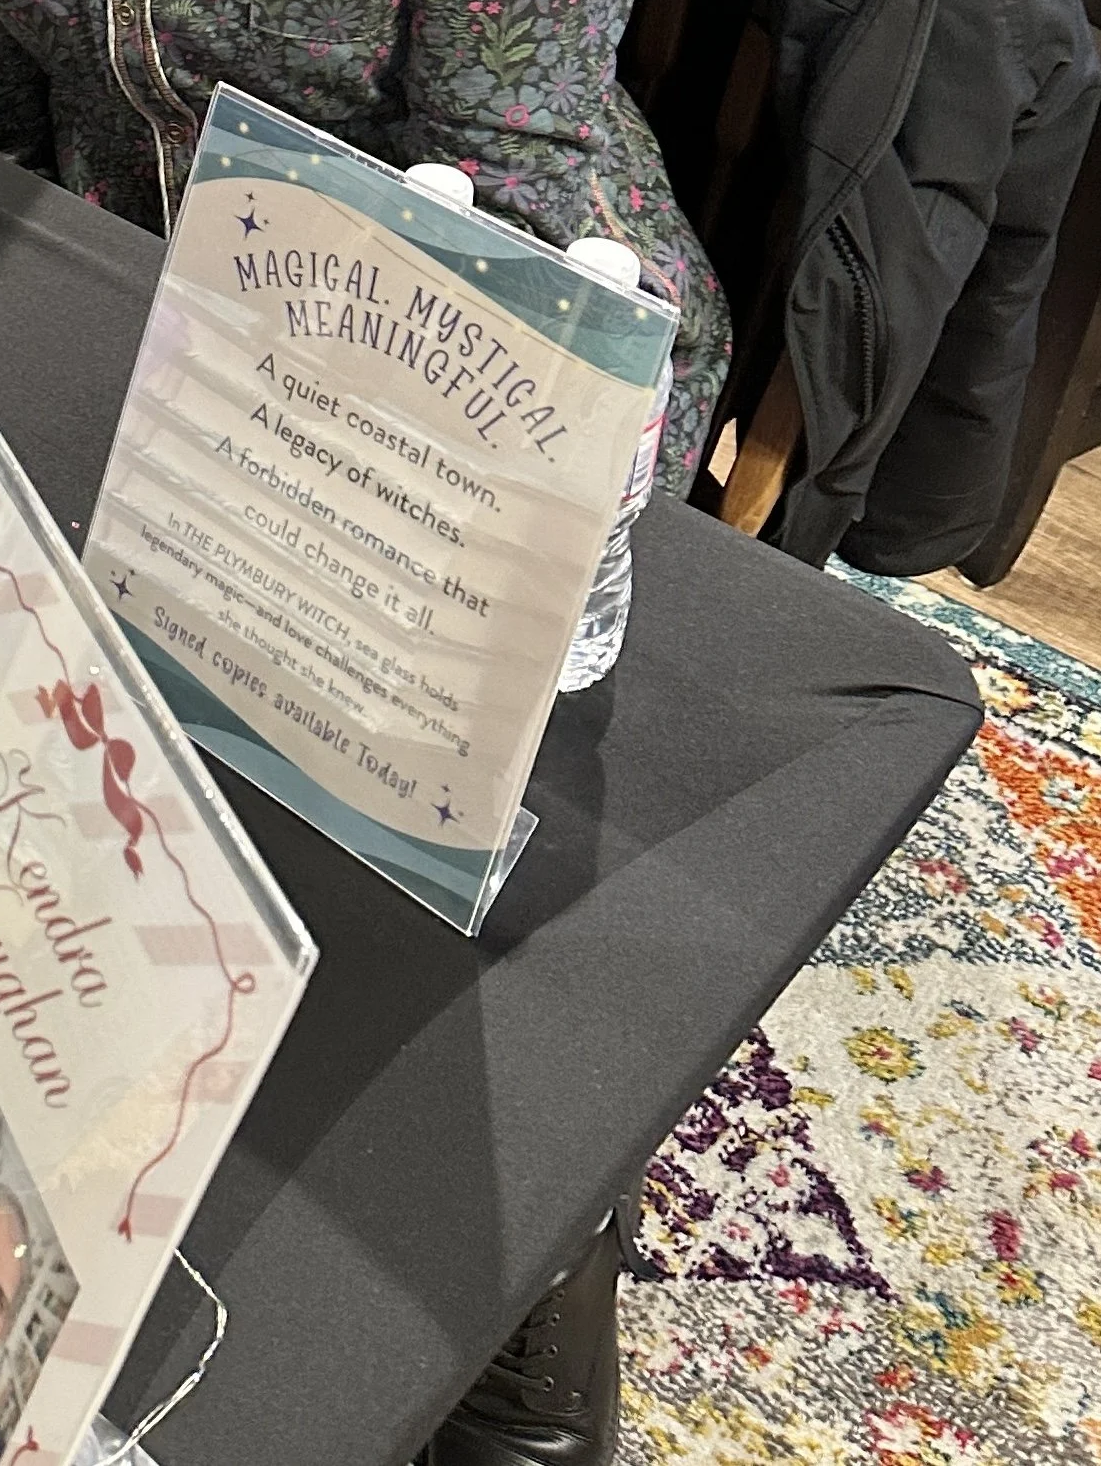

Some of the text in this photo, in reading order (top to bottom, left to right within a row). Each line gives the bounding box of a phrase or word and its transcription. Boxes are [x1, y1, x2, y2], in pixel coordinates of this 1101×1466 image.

[233, 249, 568, 464] MAGICAL. MYSTICAL.
[256, 353, 501, 512] A quiet coastal town.
[285, 300, 508, 450] MEANINGFUL.
[215, 436, 492, 618] A forbidden romance that
[250, 403, 466, 548] A legacy of witches.
[141, 524, 203, 578] legendary
[284, 619, 313, 649] love
[315, 646, 388, 699] challenges
[391, 694, 471, 757] everything
[168, 512, 459, 712] In THE PLYMBURY WITCH, sea glass holds
[218, 609, 242, 632] she
[244, 627, 299, 671] thought
[300, 665, 325, 688] she
[244, 504, 436, 636] could change it all.
[153, 605, 418, 799] Signed copies available Today!
